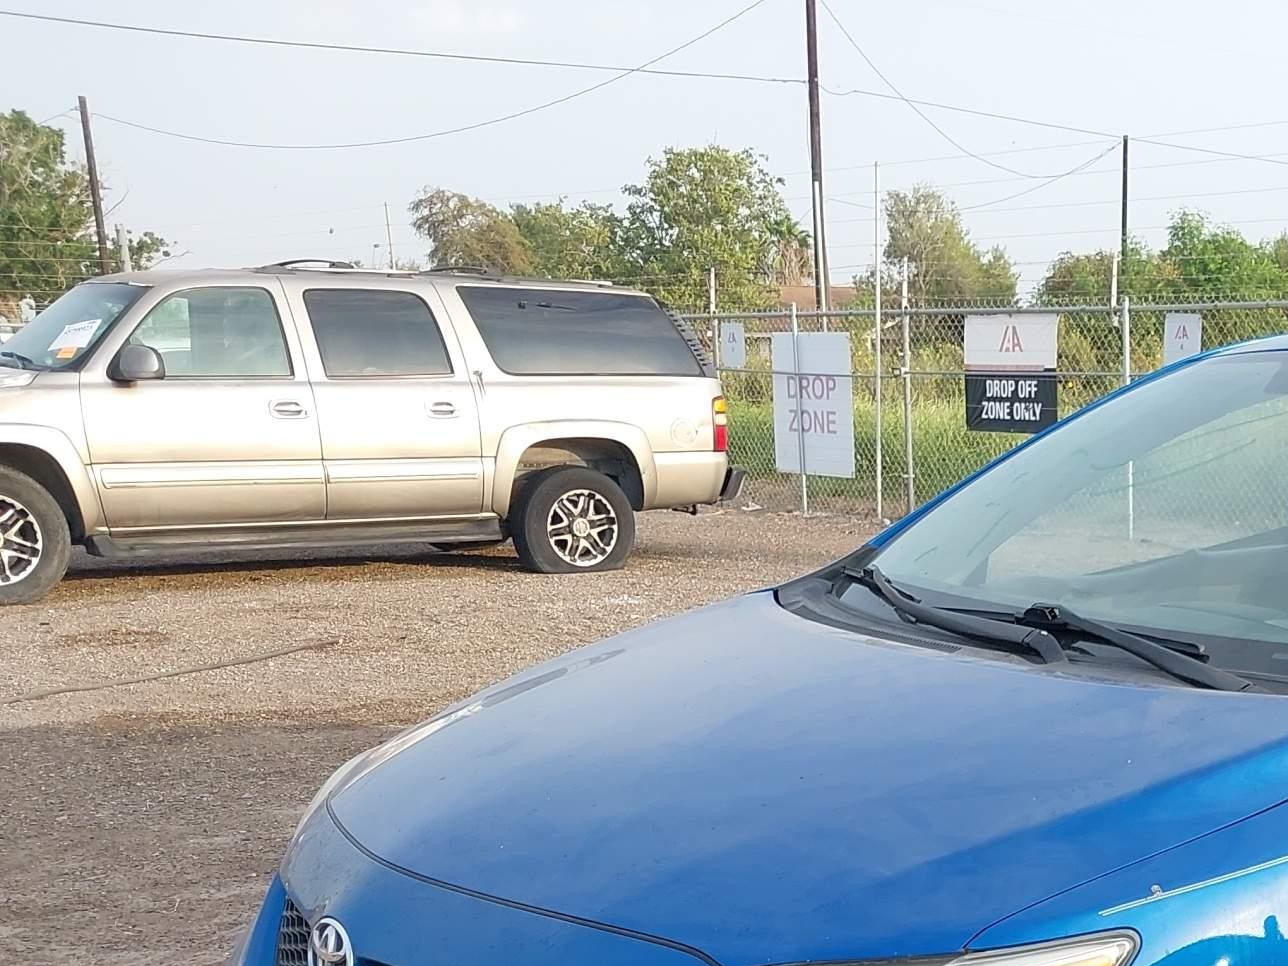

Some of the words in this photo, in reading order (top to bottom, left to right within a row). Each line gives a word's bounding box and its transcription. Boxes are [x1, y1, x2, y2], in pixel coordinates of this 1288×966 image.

[786, 375, 837, 400] DROP
[986, 379, 1016, 398] DROP
[1017, 380, 1038, 399] OFF
[788, 409, 838, 434] ZONE
[981, 401, 1011, 420] ZONE
[1012, 402, 1042, 421] ONLY
